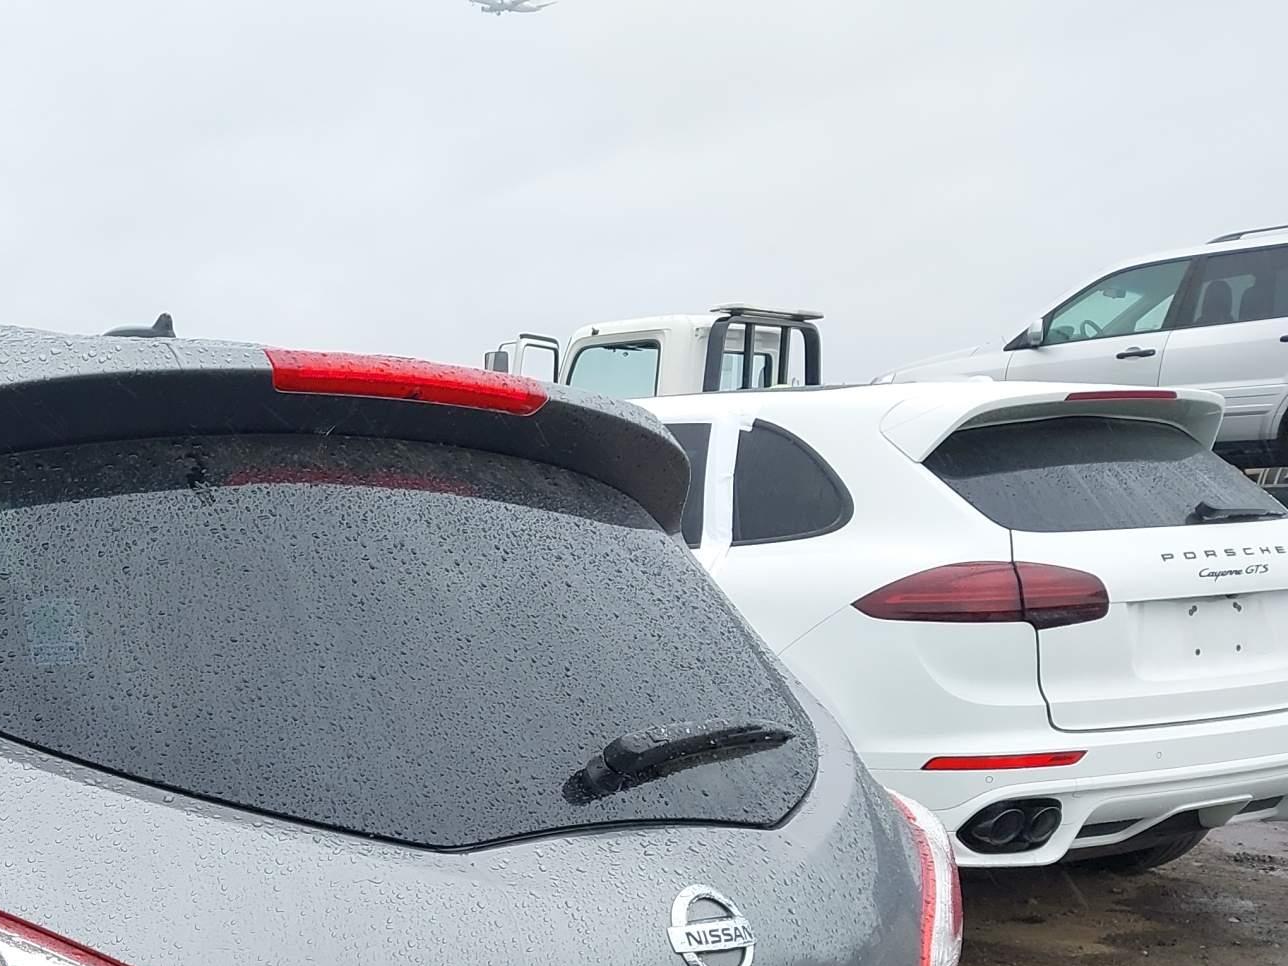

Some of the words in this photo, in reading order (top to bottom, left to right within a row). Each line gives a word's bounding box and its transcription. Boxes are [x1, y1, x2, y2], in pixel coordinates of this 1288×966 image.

[1161, 546, 1287, 561] PORSCHE
[1198, 568, 1242, 582] Cayenne
[1245, 564, 1269, 574] GTS
[685, 925, 753, 946] NISSAN
